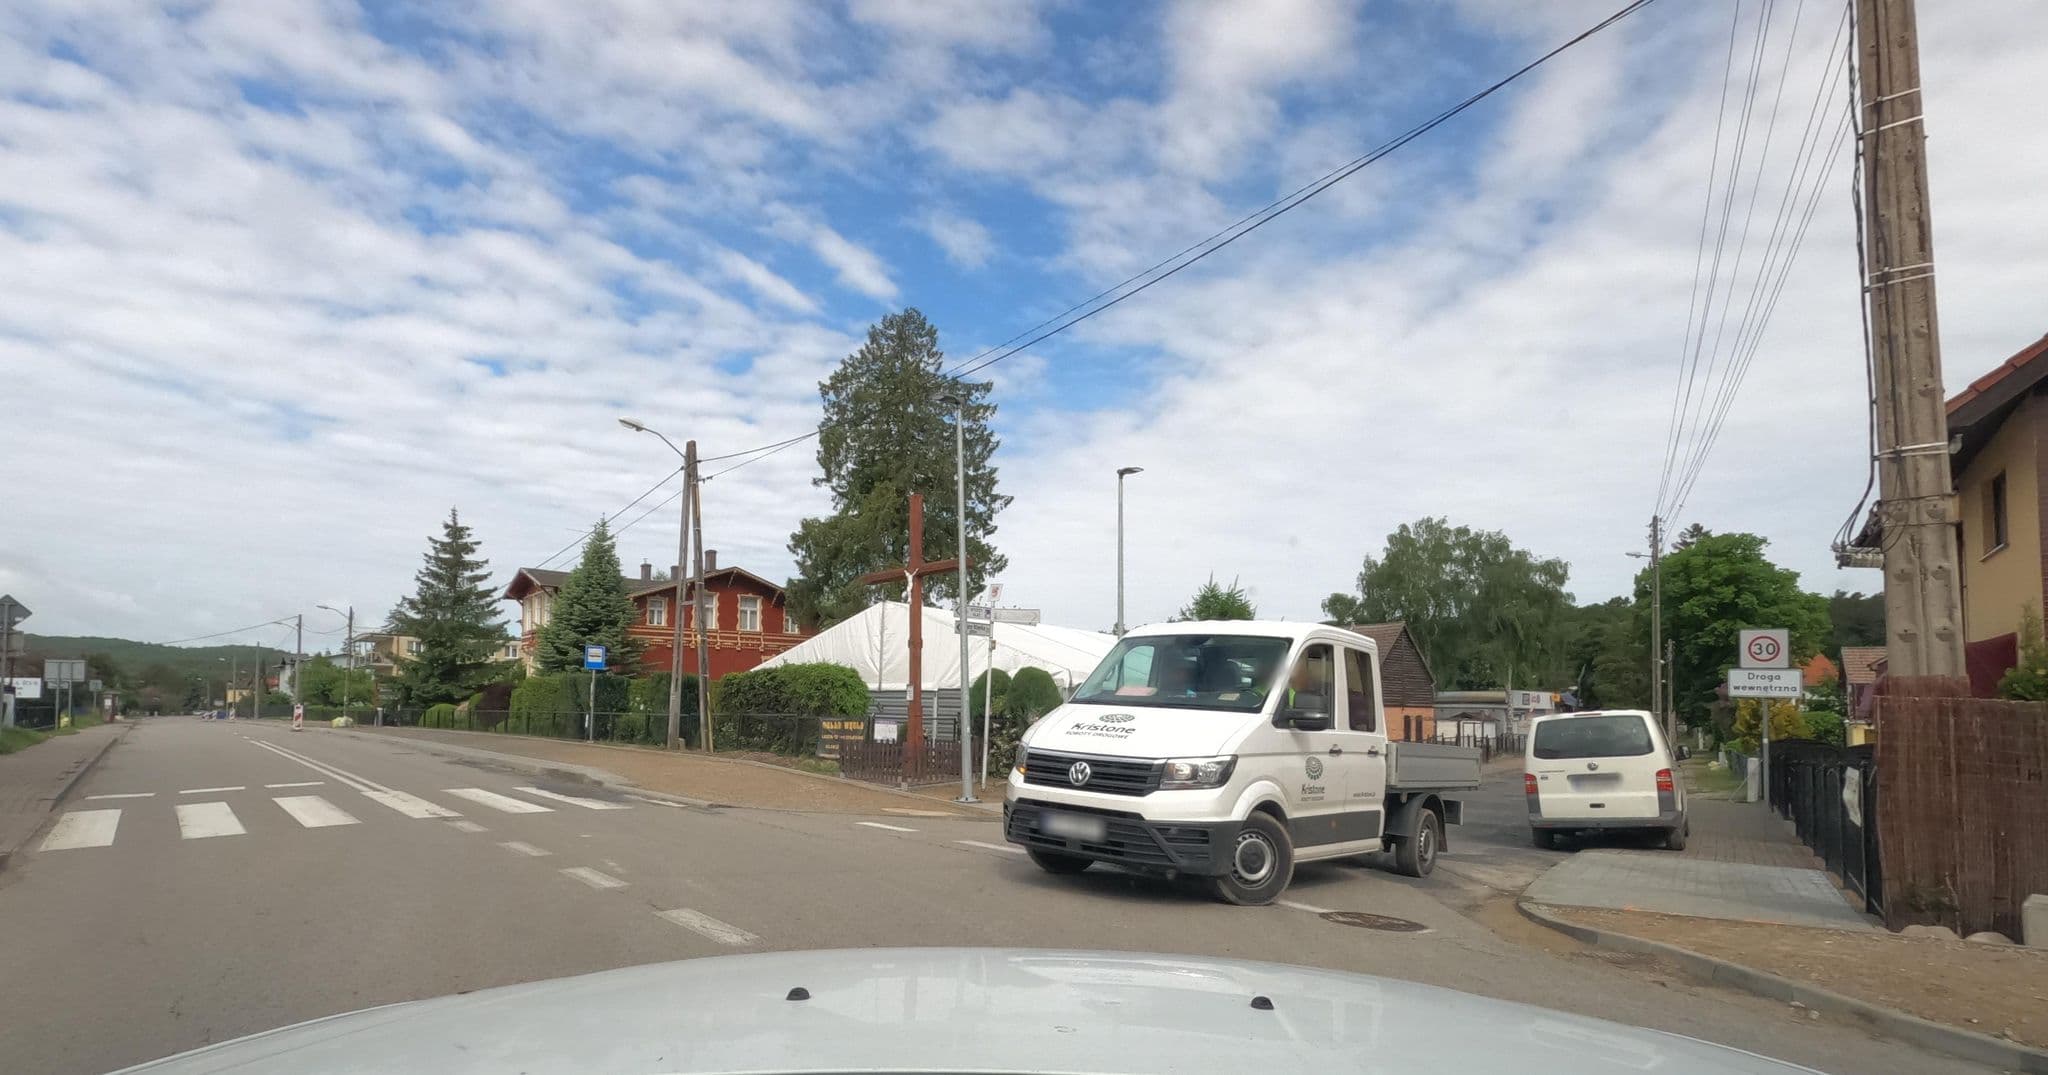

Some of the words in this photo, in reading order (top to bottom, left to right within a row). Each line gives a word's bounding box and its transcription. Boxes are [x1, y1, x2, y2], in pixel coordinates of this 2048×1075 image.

[1753, 643, 1776, 655] 30
[1747, 672, 1781, 682] Droga
[1733, 684, 1797, 693] wewnętrzna
[1070, 722, 1136, 734] Kristone
